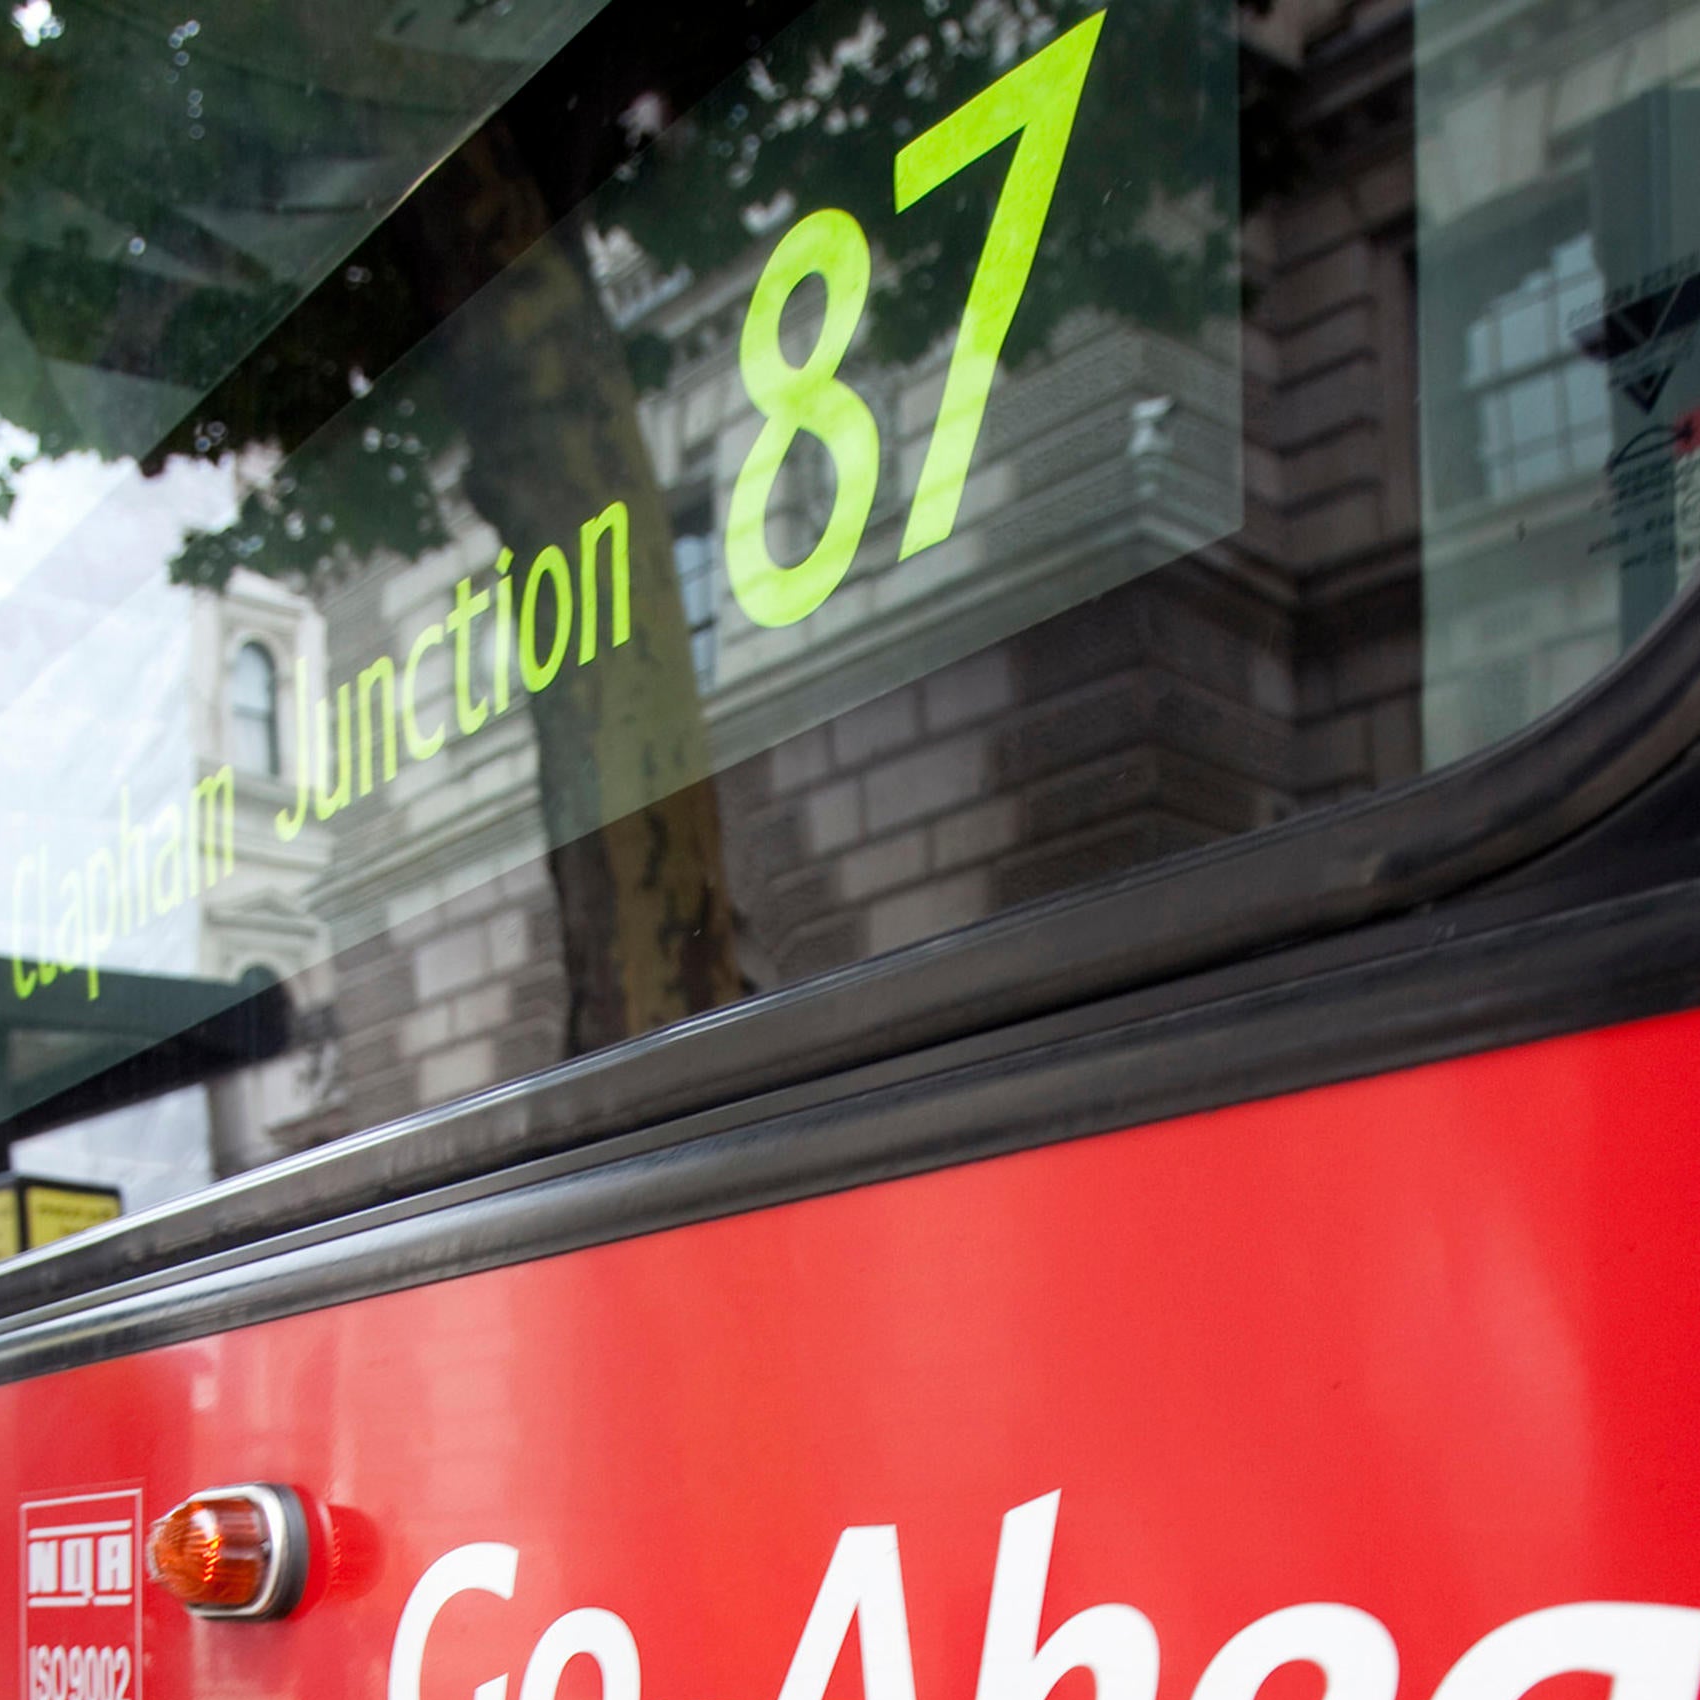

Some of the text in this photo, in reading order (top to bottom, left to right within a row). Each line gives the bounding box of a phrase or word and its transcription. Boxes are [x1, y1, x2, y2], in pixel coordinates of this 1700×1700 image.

[724, 10, 1107, 628] 87
[12, 764, 235, 1001] Clapham
[275, 500, 632, 843] Junction
[28, 1533, 133, 1601] NQA
